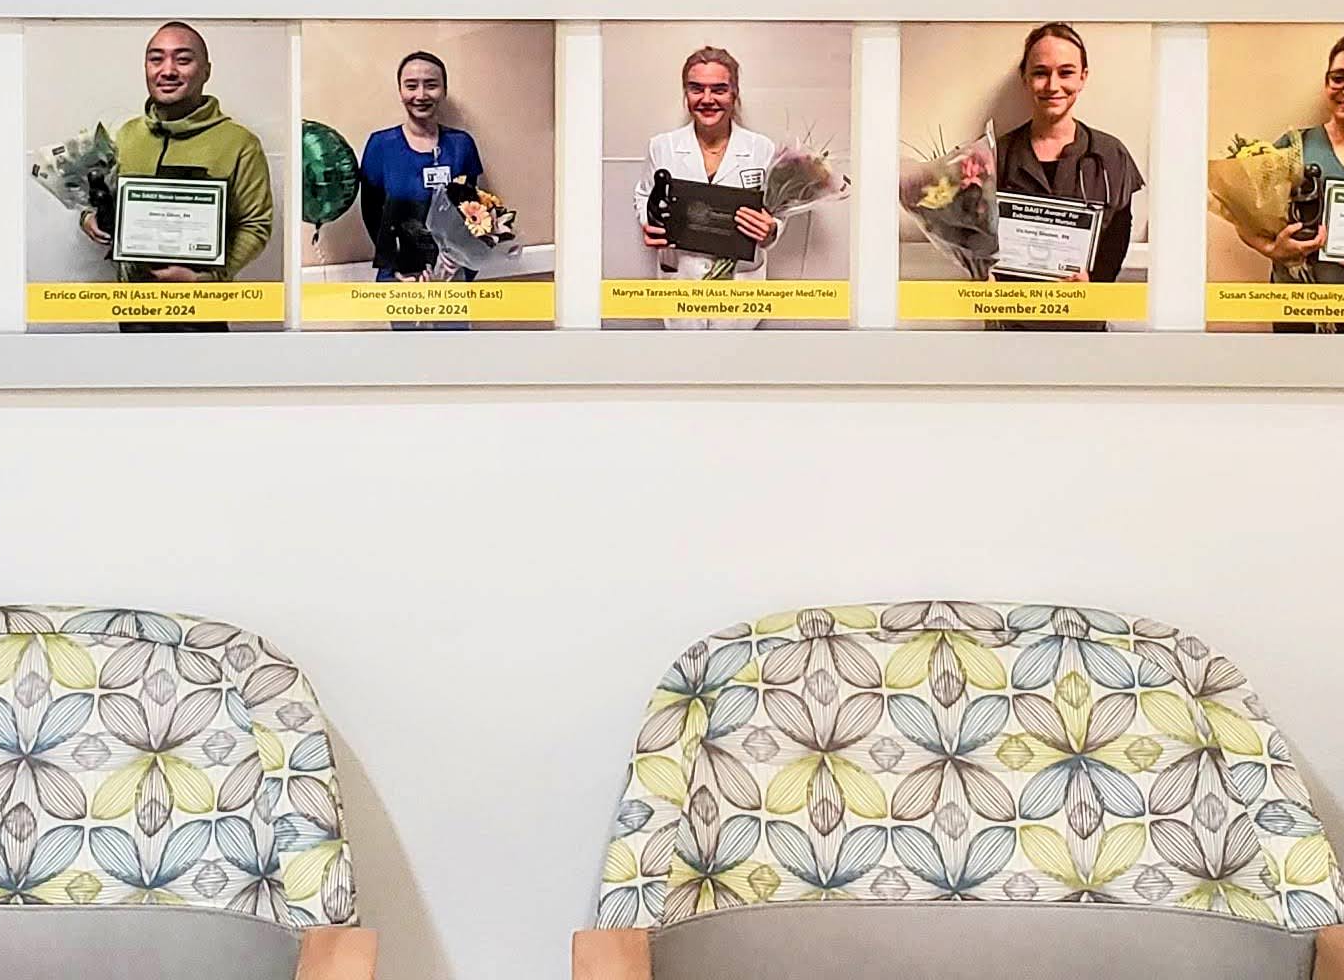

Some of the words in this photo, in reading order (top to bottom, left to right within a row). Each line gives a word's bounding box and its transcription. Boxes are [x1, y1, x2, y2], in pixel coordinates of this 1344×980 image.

[43, 290, 76, 300] Enrico
[78, 290, 111, 300] Giron,
[112, 290, 127, 299] RN
[130, 289, 158, 300] (Asst.
[160, 290, 190, 299] Nurse
[192, 289, 239, 301] Manager
[241, 289, 263, 300] ICU)
[351, 289, 386, 299] Dionee
[389, 289, 425, 299] Santos,
[427, 289, 441, 298] RN
[444, 288, 477, 299] (South
[479, 288, 503, 300] East)
[111, 304, 162, 315] October
[164, 305, 195, 315] 2024
[386, 304, 435, 314] October
[438, 304, 467, 314] 2024
[677, 301, 739, 312] November
[742, 302, 771, 313] 2024
[974, 302, 1037, 314] November
[1039, 303, 1069, 314] 2024
